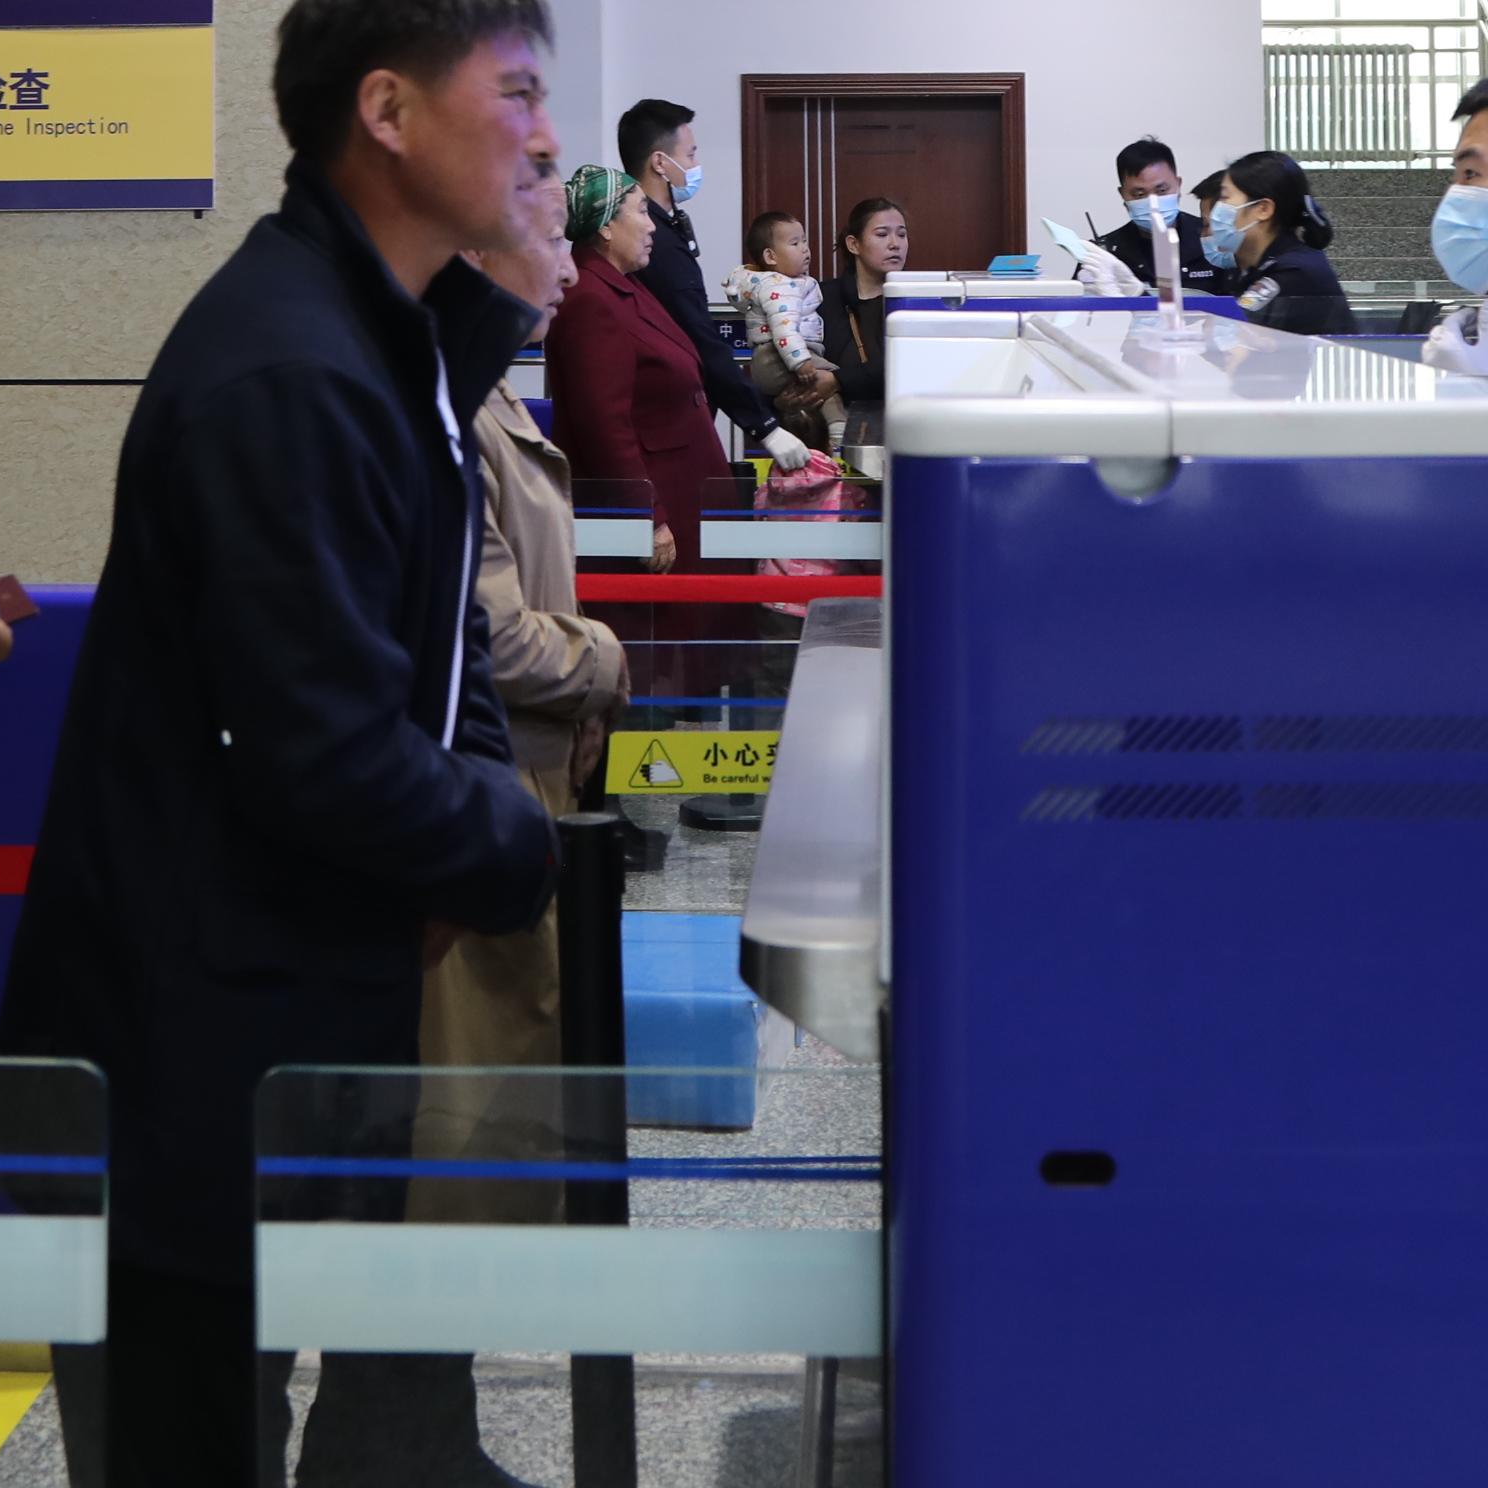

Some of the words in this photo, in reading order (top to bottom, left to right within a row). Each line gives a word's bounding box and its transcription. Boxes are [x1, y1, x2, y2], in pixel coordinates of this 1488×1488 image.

[26, 116, 129, 137] Inspection
[719, 323, 733, 339] 中
[703, 774, 718, 783] Be
[721, 774, 759, 783] careful
